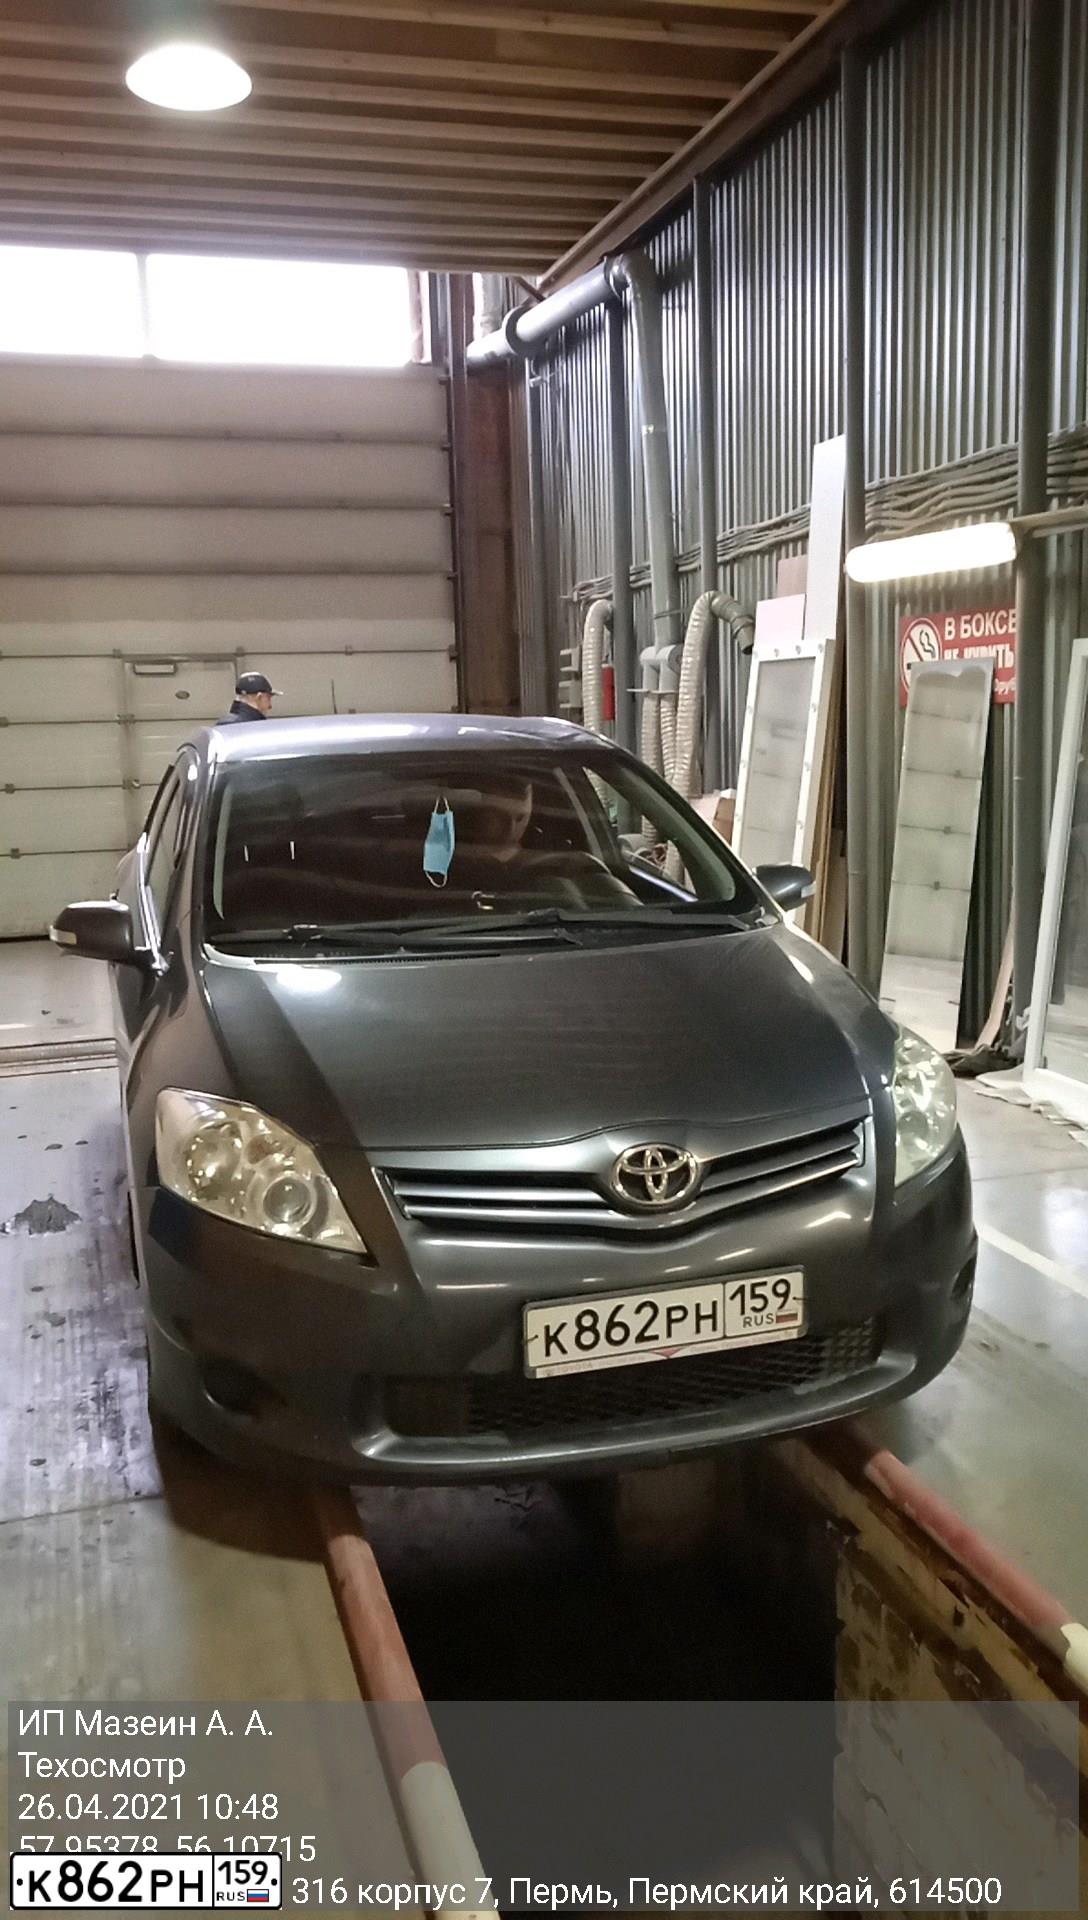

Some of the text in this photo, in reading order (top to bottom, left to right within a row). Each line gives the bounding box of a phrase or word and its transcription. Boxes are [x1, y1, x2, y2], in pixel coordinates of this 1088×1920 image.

[944, 616, 956, 641] В
[544, 1300, 718, 1357] К862РН
[729, 1278, 792, 1316] 159
[742, 1313, 775, 1329] RUS
